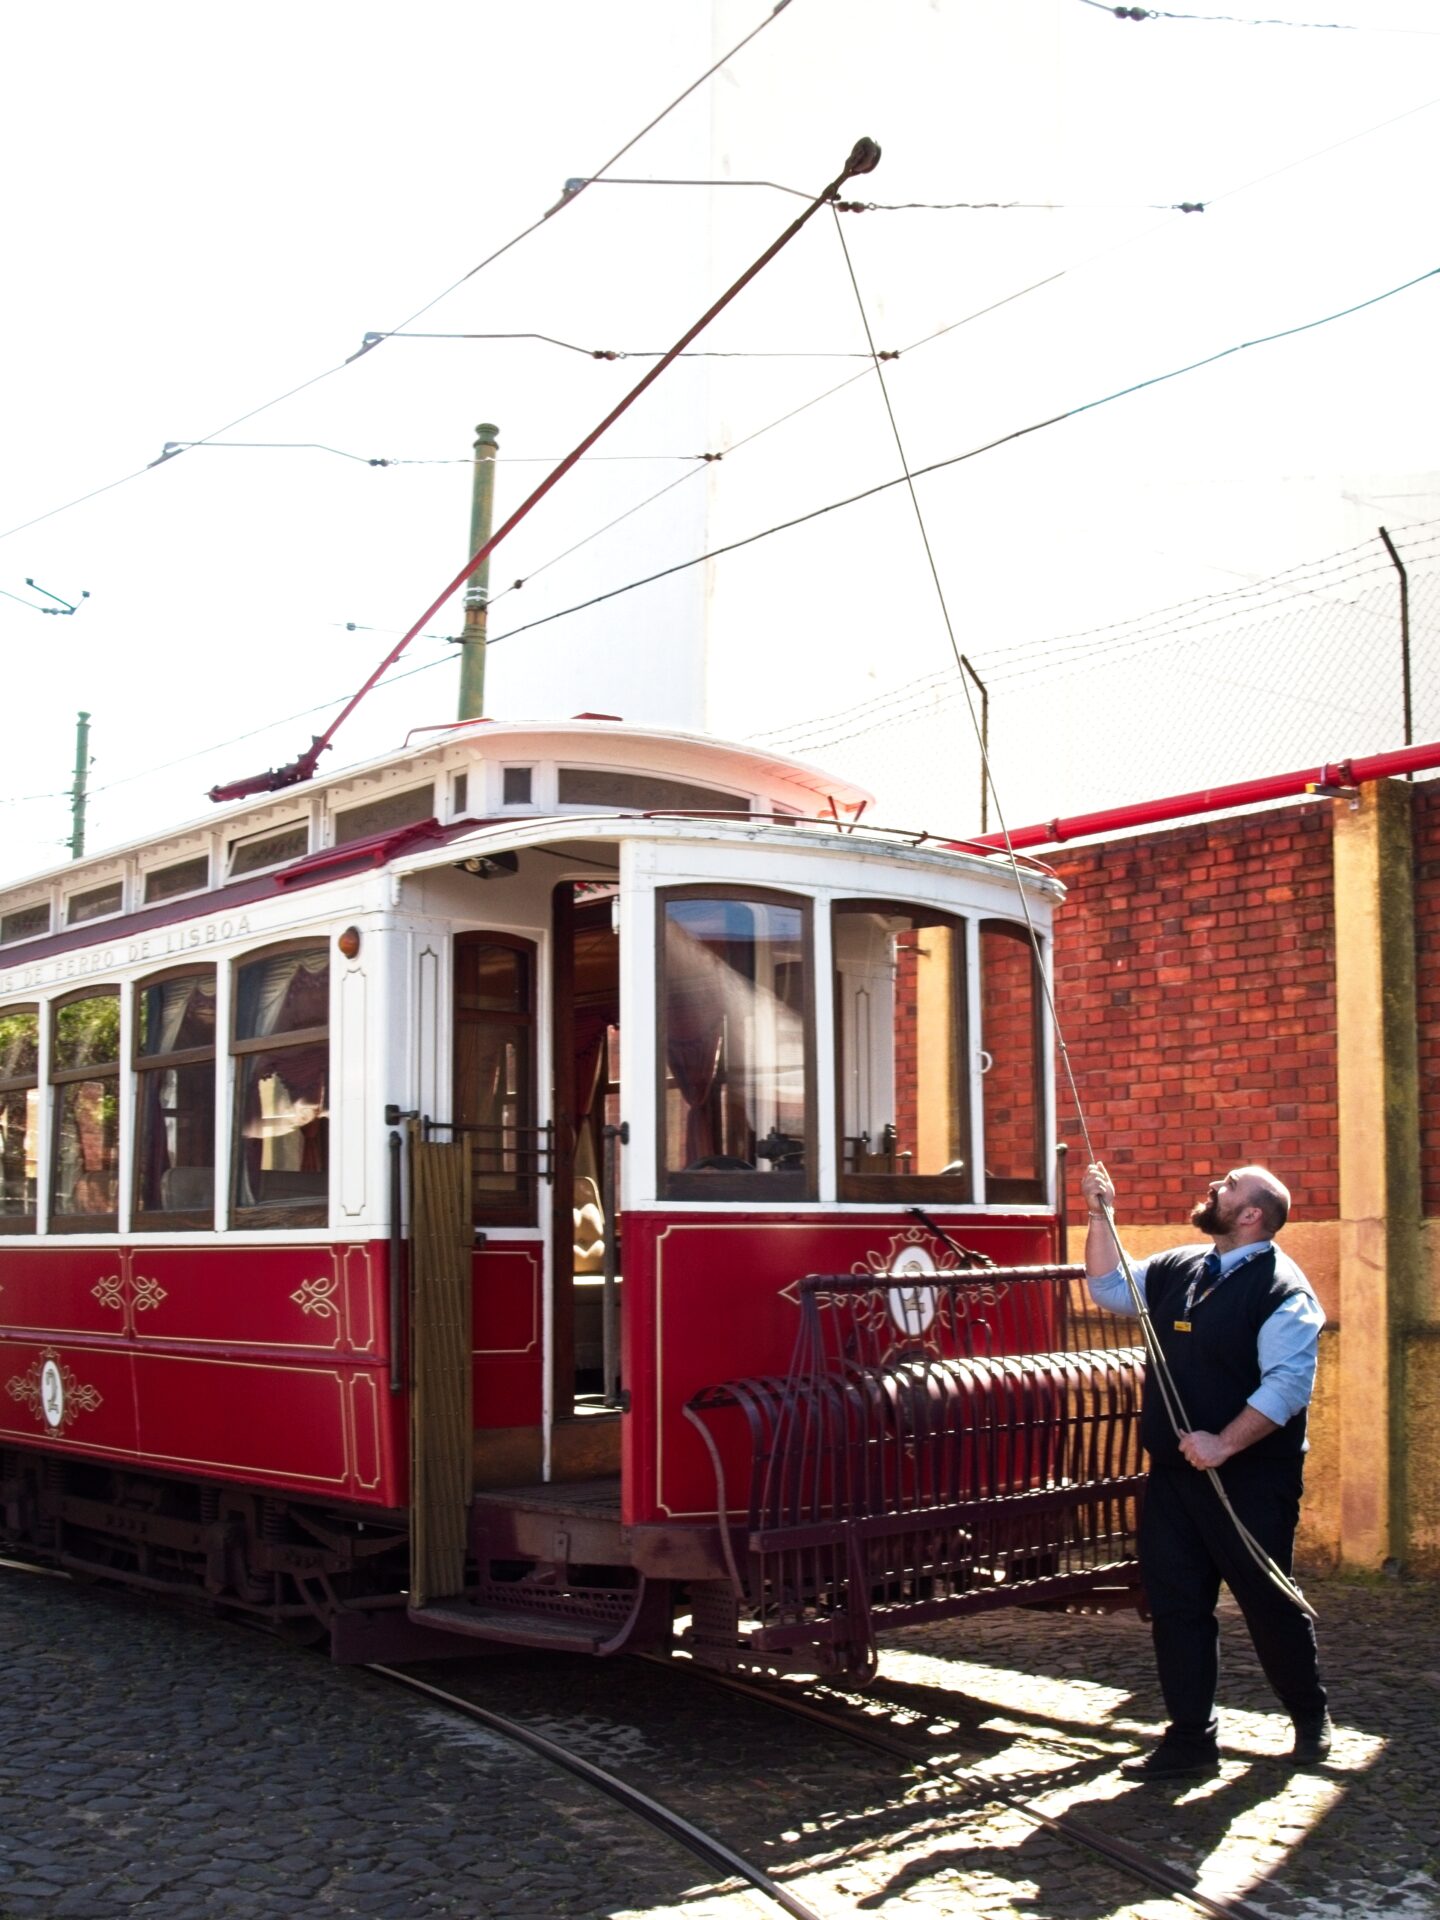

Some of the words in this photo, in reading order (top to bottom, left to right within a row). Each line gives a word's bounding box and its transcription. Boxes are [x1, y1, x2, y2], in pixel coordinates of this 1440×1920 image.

[24, 968, 42, 986] DE
[55, 951, 114, 980] FERRO
[128, 940, 151, 962] DE
[166, 914, 250, 953] LISBOA
